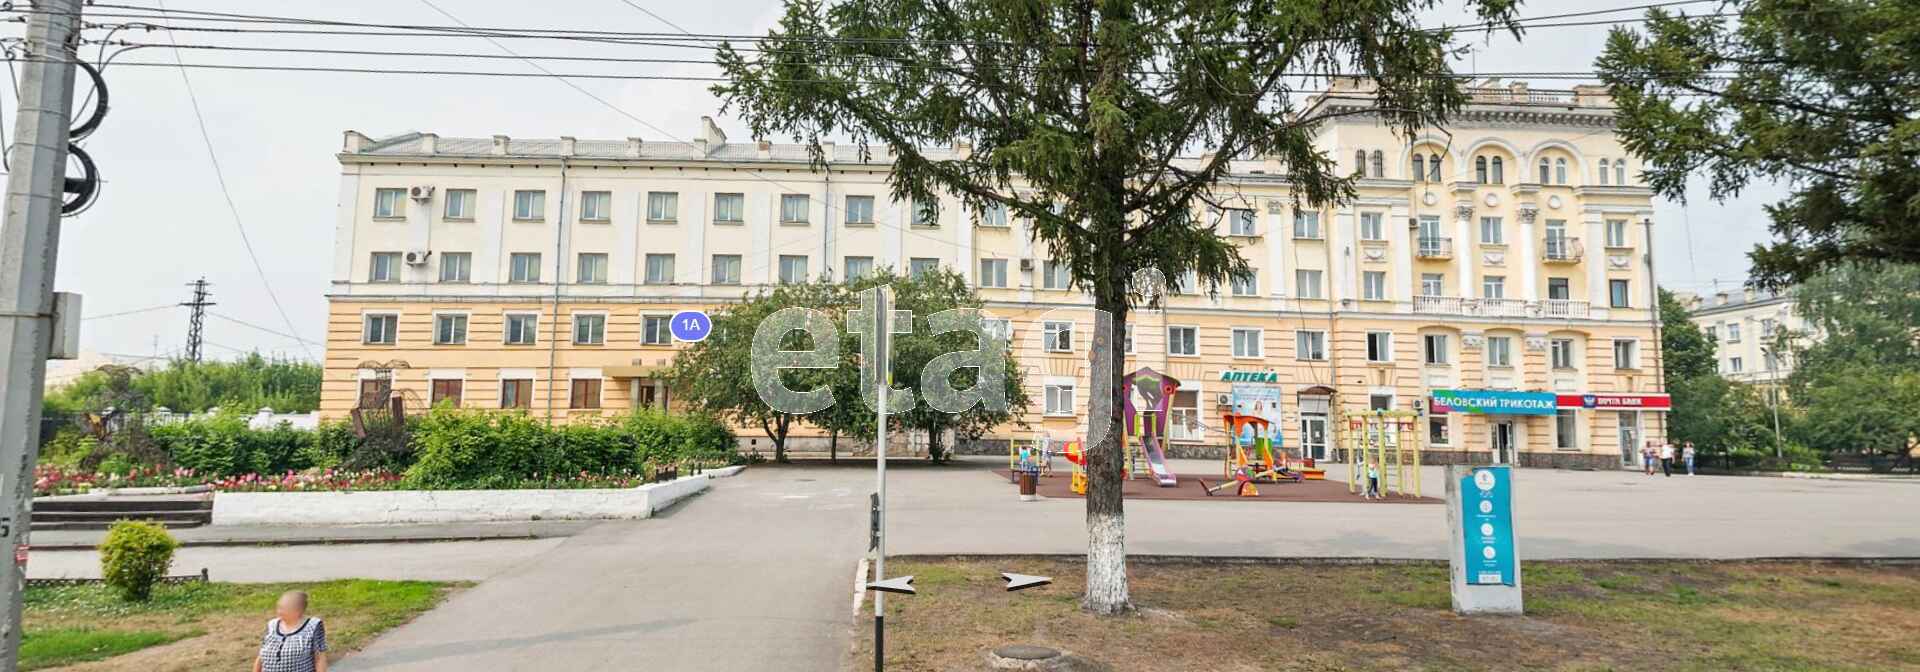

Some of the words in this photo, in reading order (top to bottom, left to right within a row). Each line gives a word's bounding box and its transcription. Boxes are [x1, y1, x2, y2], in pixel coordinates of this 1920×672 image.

[1220, 371, 1278, 383] АПТЕКА
[1433, 396, 1498, 408] БЕЛОВСКИЙ
[1500, 398, 1554, 409] ТРИКОТАЖ
